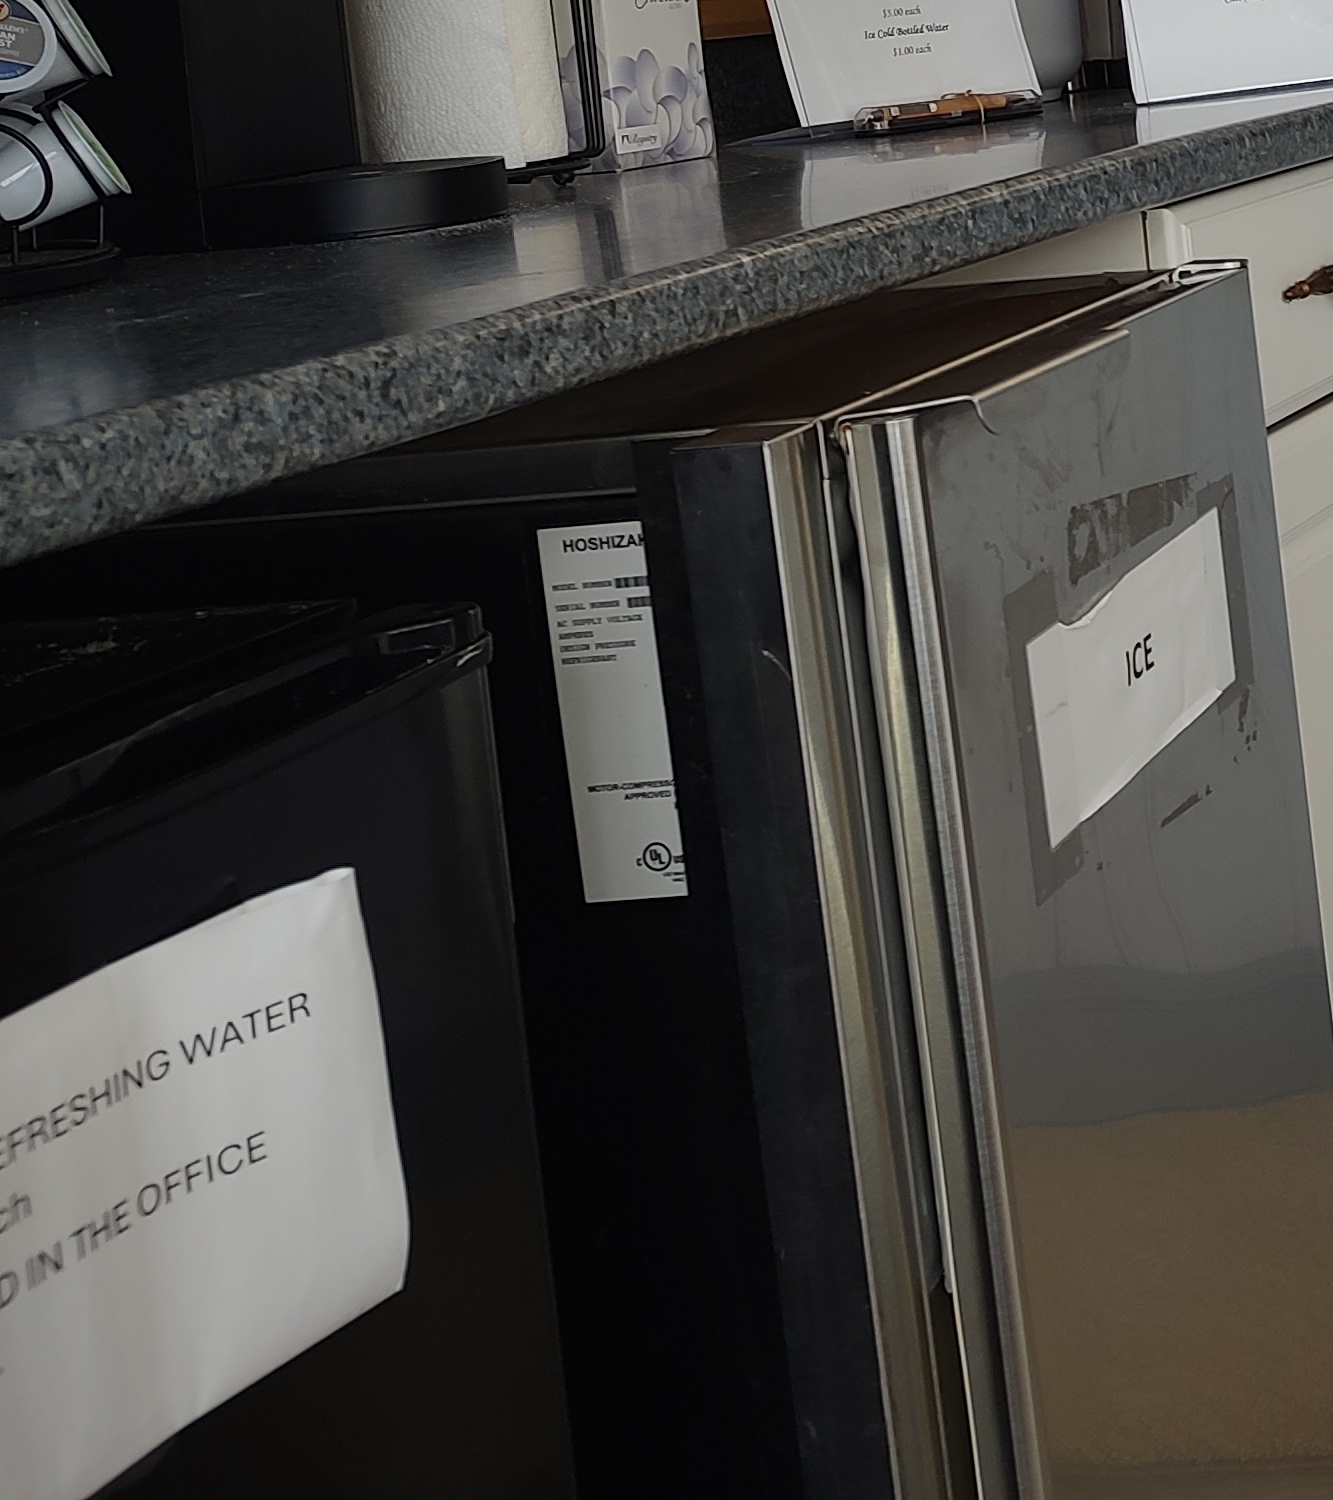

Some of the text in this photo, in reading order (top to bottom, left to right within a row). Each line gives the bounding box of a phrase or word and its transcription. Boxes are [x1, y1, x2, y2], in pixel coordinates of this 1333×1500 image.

[882, 4, 921, 18] $5.00 each
[864, 22, 949, 40] Ice Cold Bottled Water
[893, 43, 932, 57] $1.00 each
[1125, 633, 1155, 686] ICE
[587, 780, 675, 793] MOTOR-COMPRESSO
[0, 992, 311, 1171] EFRESHING WATER
[0, 1192, 33, 1235] ch
[25, 1239, 65, 1291] IN
[68, 1198, 132, 1261] THE
[136, 1130, 269, 1217] OFFICE
